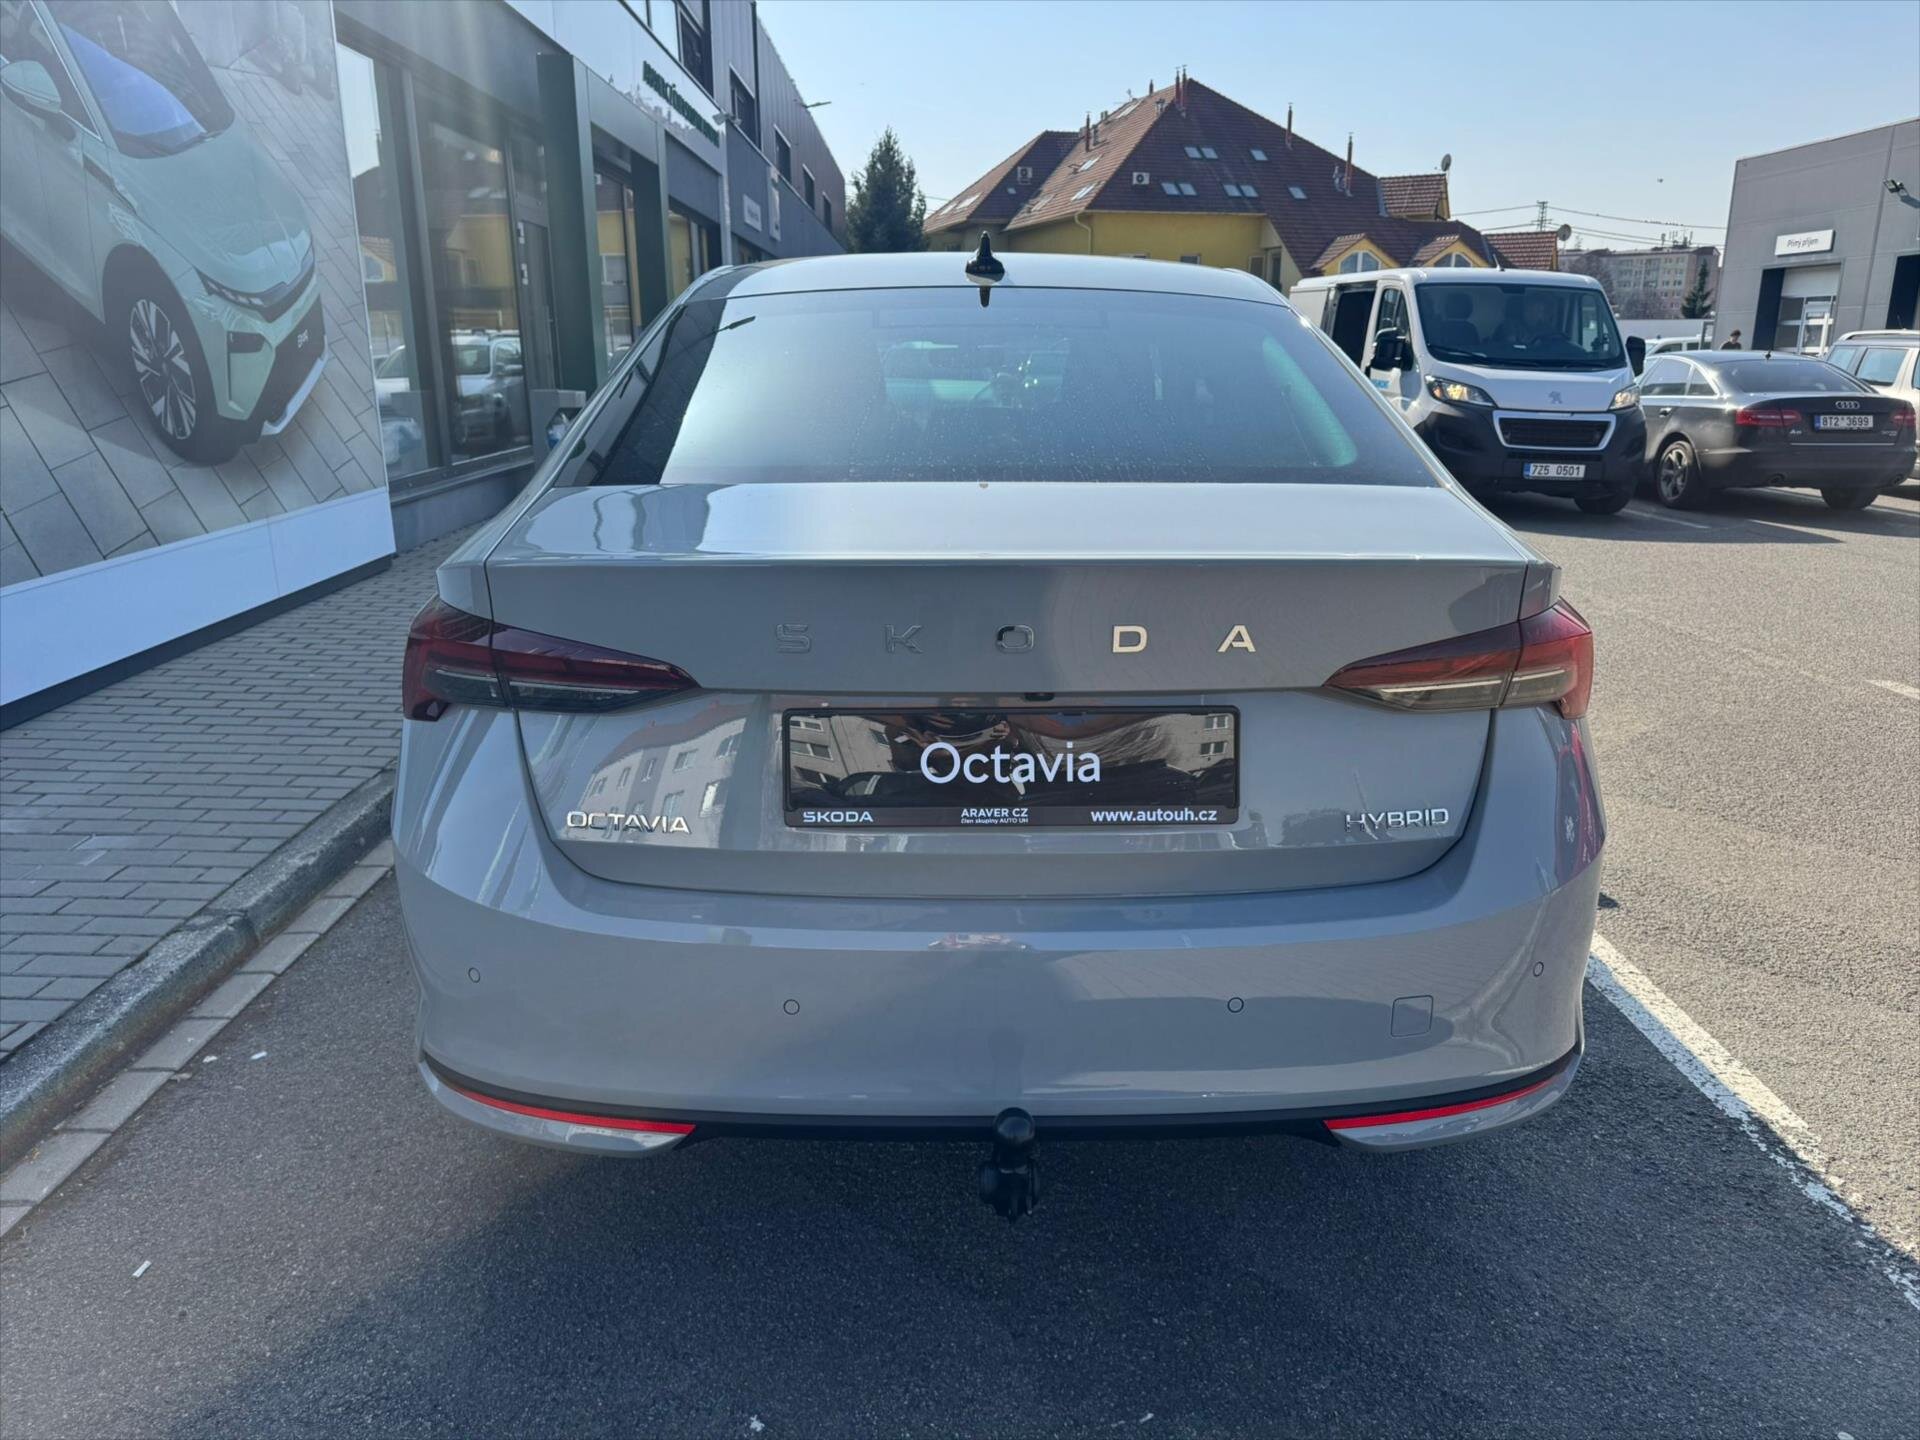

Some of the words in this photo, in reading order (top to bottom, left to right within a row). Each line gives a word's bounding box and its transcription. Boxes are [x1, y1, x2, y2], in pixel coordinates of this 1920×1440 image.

[1822, 416, 1839, 427] 8T2
[1846, 416, 1869, 427] 3699
[1532, 464, 1550, 475] 7Z5
[1556, 465, 1581, 476] 0501
[920, 741, 1101, 784] Octavia
[961, 808, 1008, 817] ARAVER
[1012, 808, 1029, 817] CZ
[1090, 808, 1218, 822] www.autouh.cz
[566, 811, 692, 834] OCTAVIA
[1345, 808, 1449, 832] HYBRID
